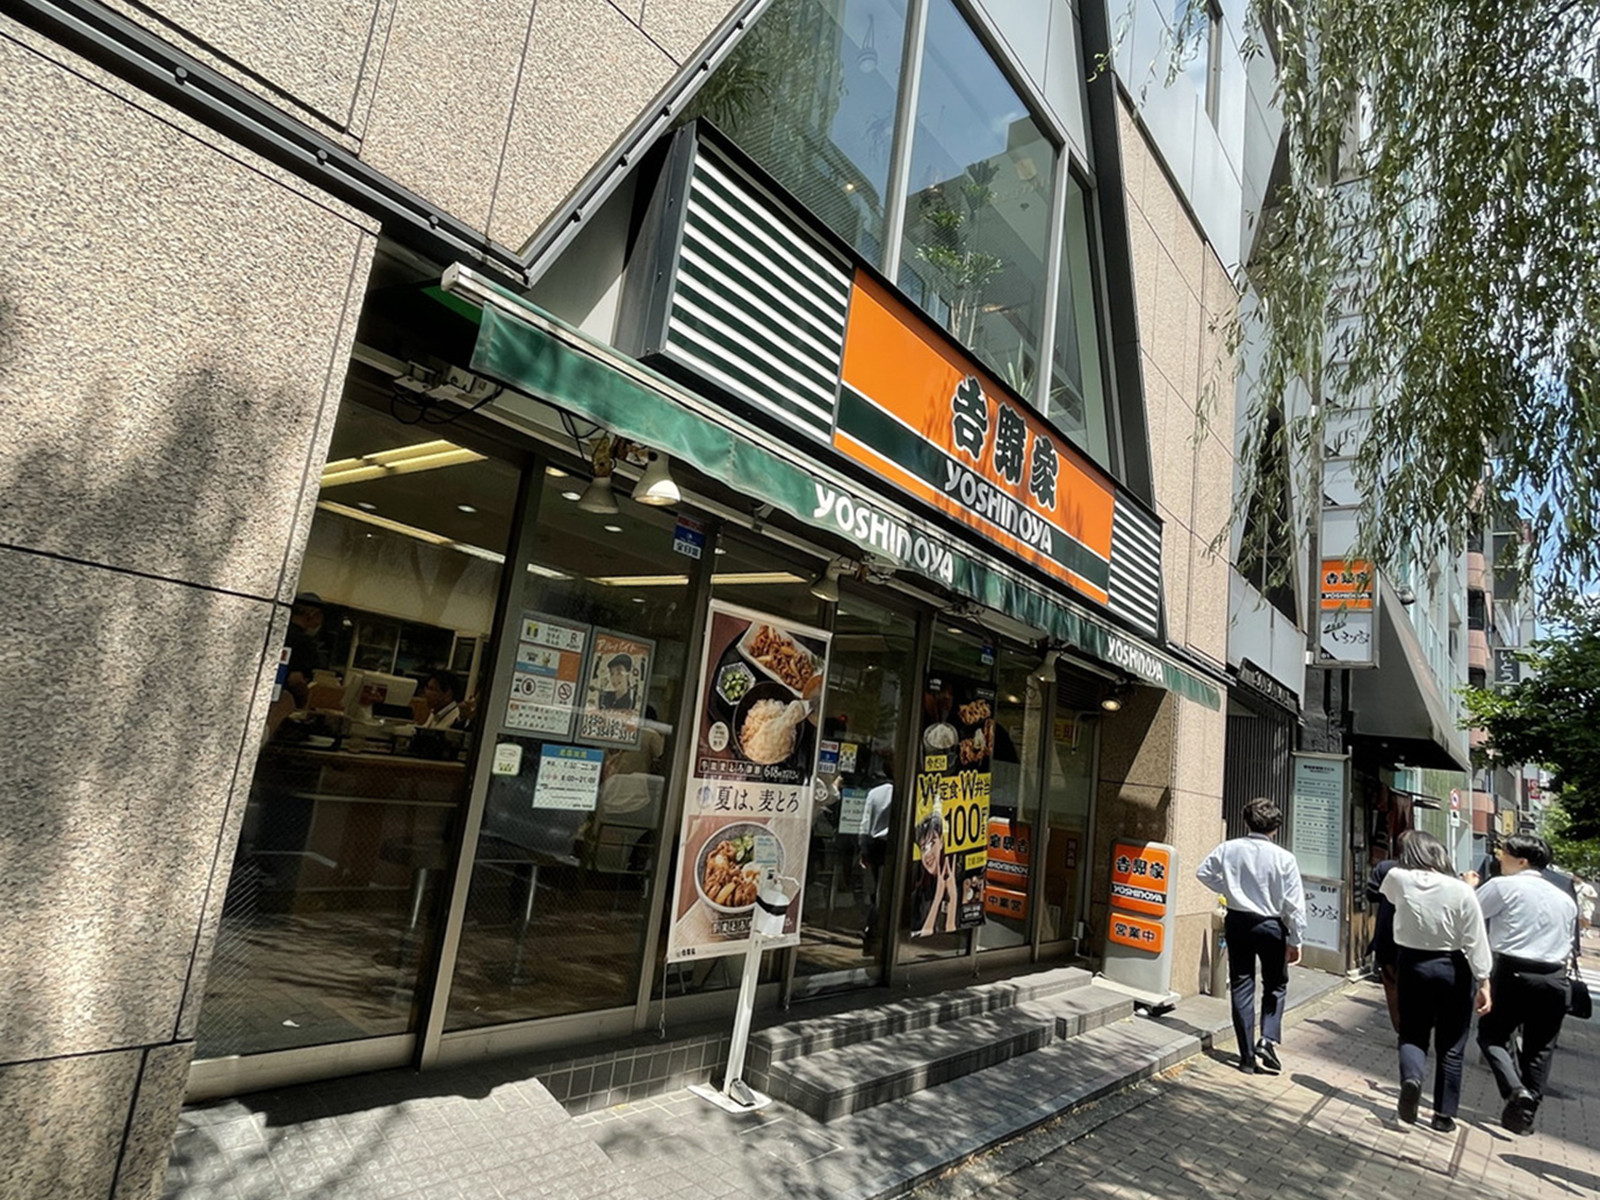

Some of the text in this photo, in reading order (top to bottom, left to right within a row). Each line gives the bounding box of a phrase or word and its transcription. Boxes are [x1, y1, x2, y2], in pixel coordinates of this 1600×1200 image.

[944, 458, 1054, 555] YOSHINOYA
[813, 483, 954, 584] YOSHINOYA
[1107, 636, 1164, 683] YOSHINOYA
[944, 803, 981, 848] 100
[1113, 885, 1163, 903] YOSHINOYA
[1115, 922, 1155, 942] 営業中
